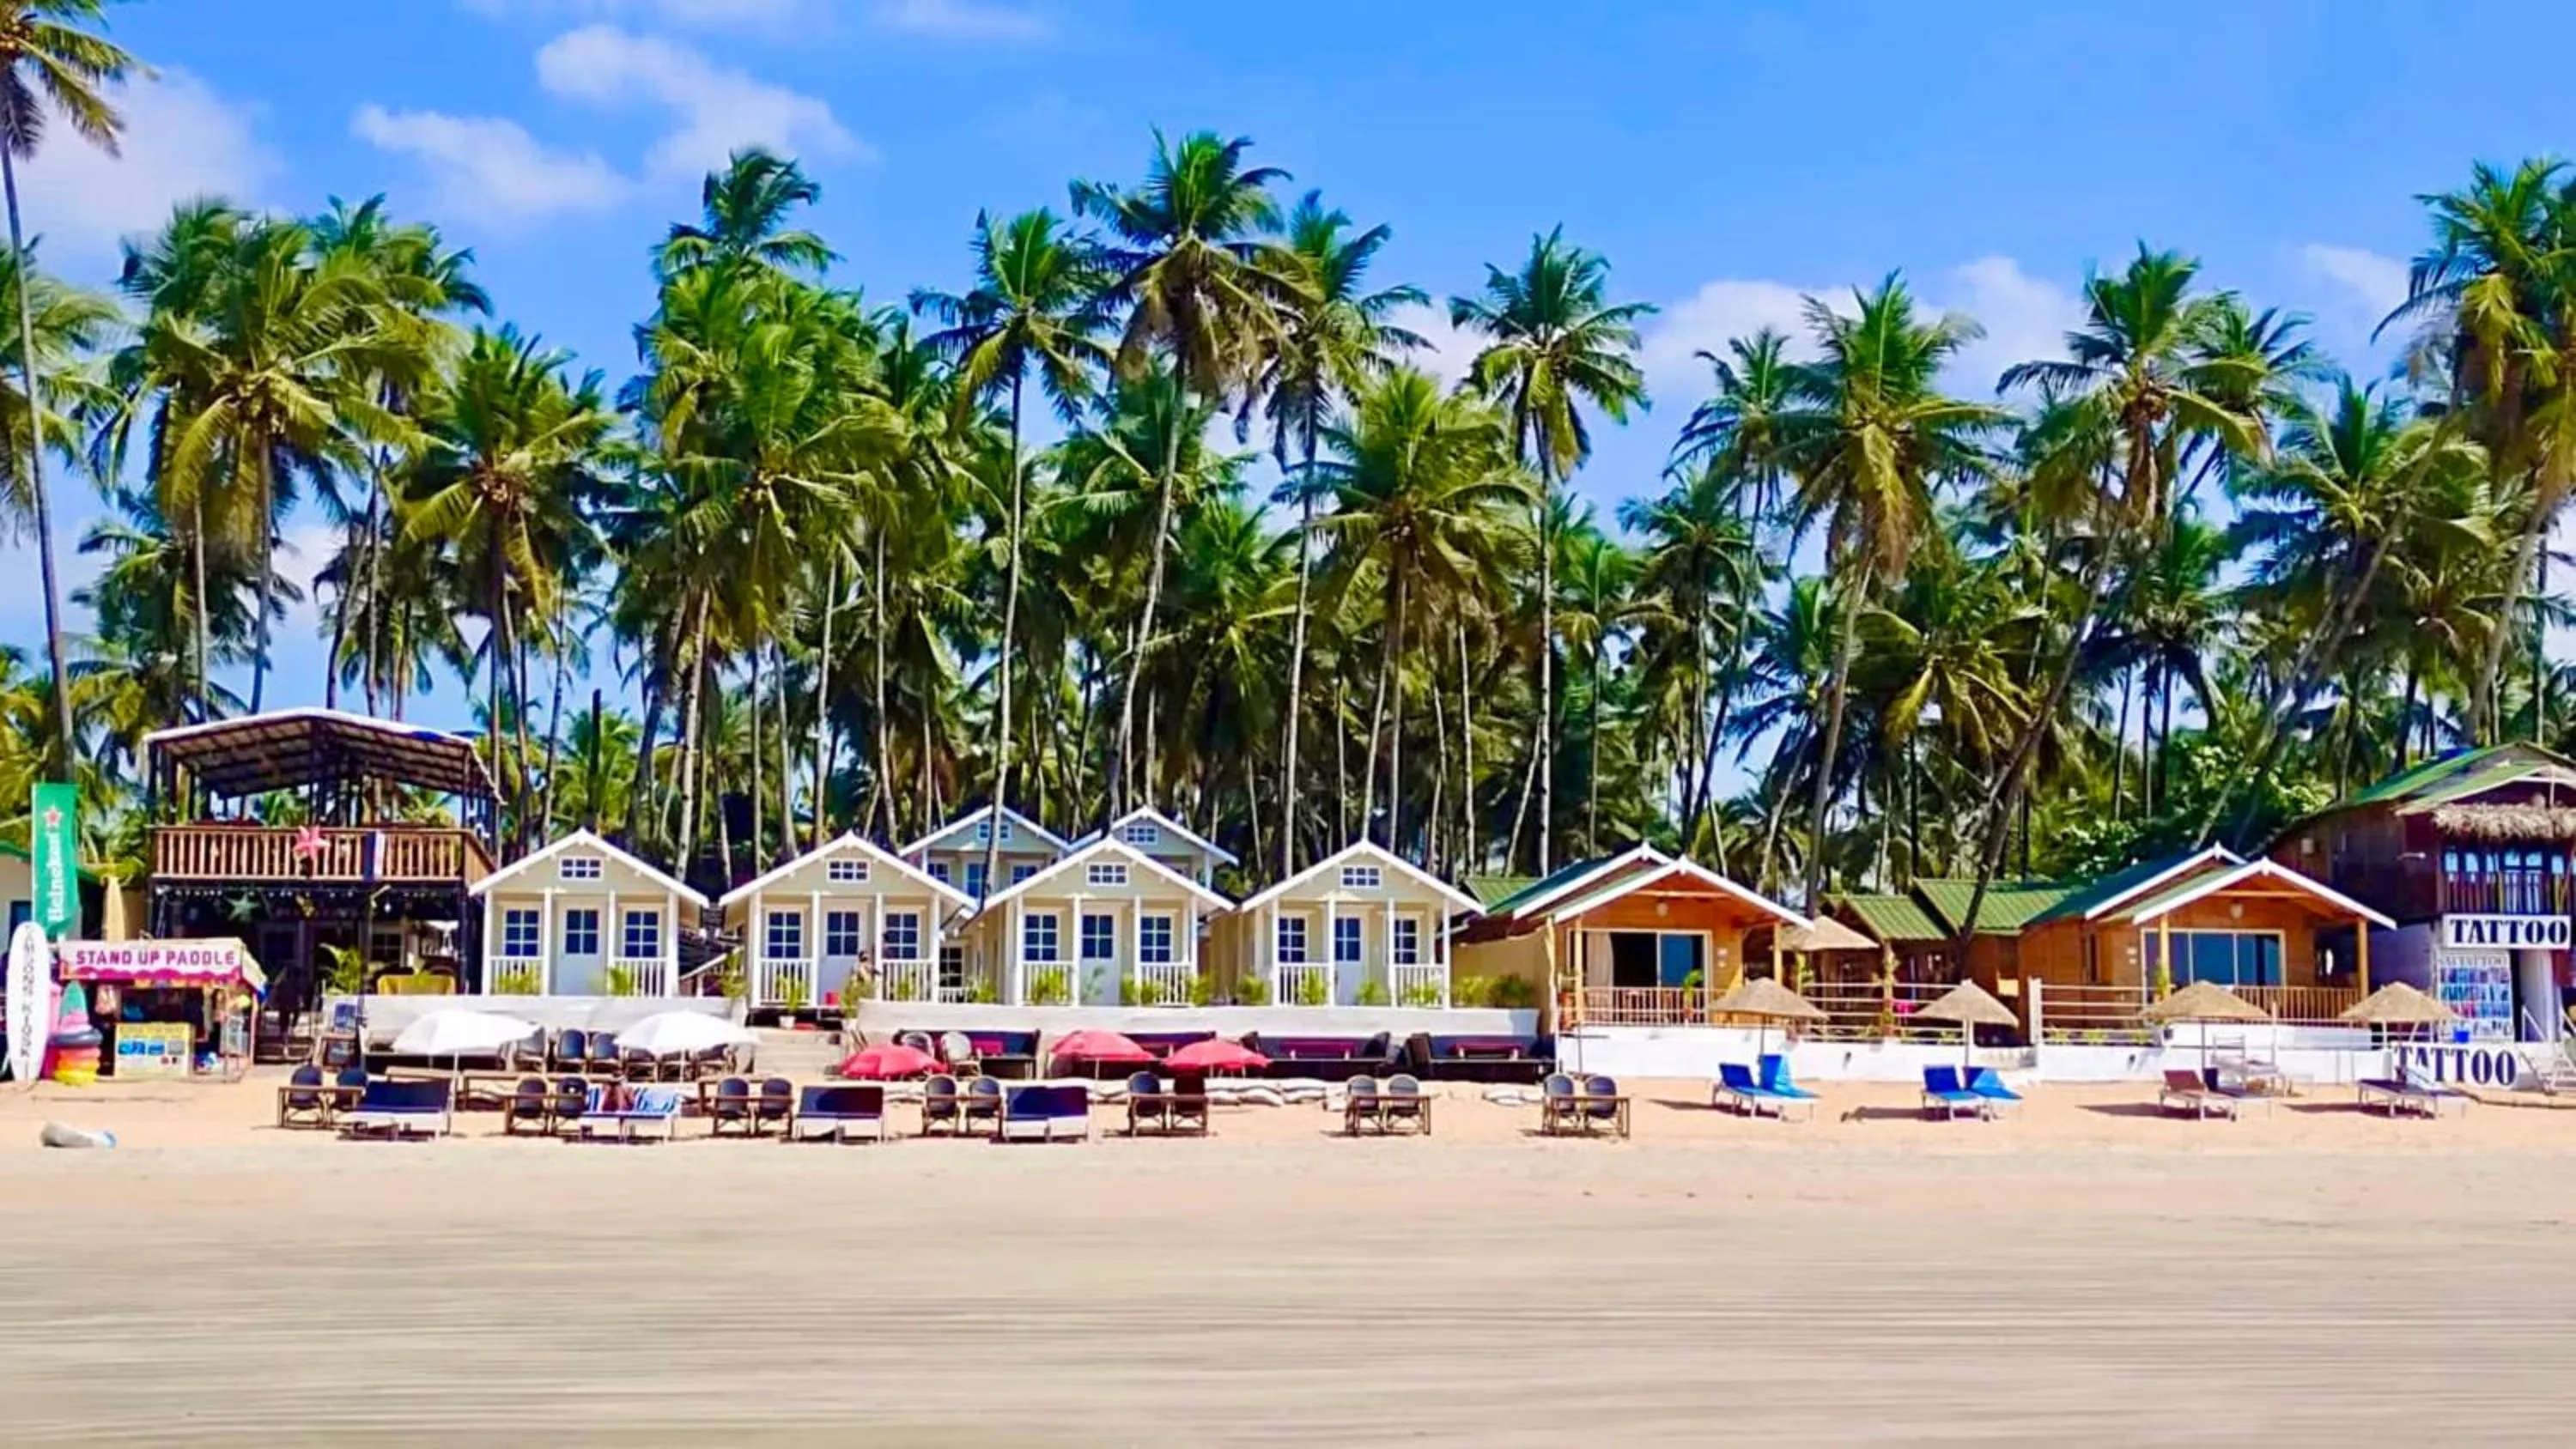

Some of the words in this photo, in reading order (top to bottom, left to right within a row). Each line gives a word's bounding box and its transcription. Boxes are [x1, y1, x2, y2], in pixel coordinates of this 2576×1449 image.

[2451, 919, 2568, 944] TATTOO
[76, 950, 131, 965] STAND
[137, 950, 161, 965] UP
[166, 950, 235, 965] PADDLE
